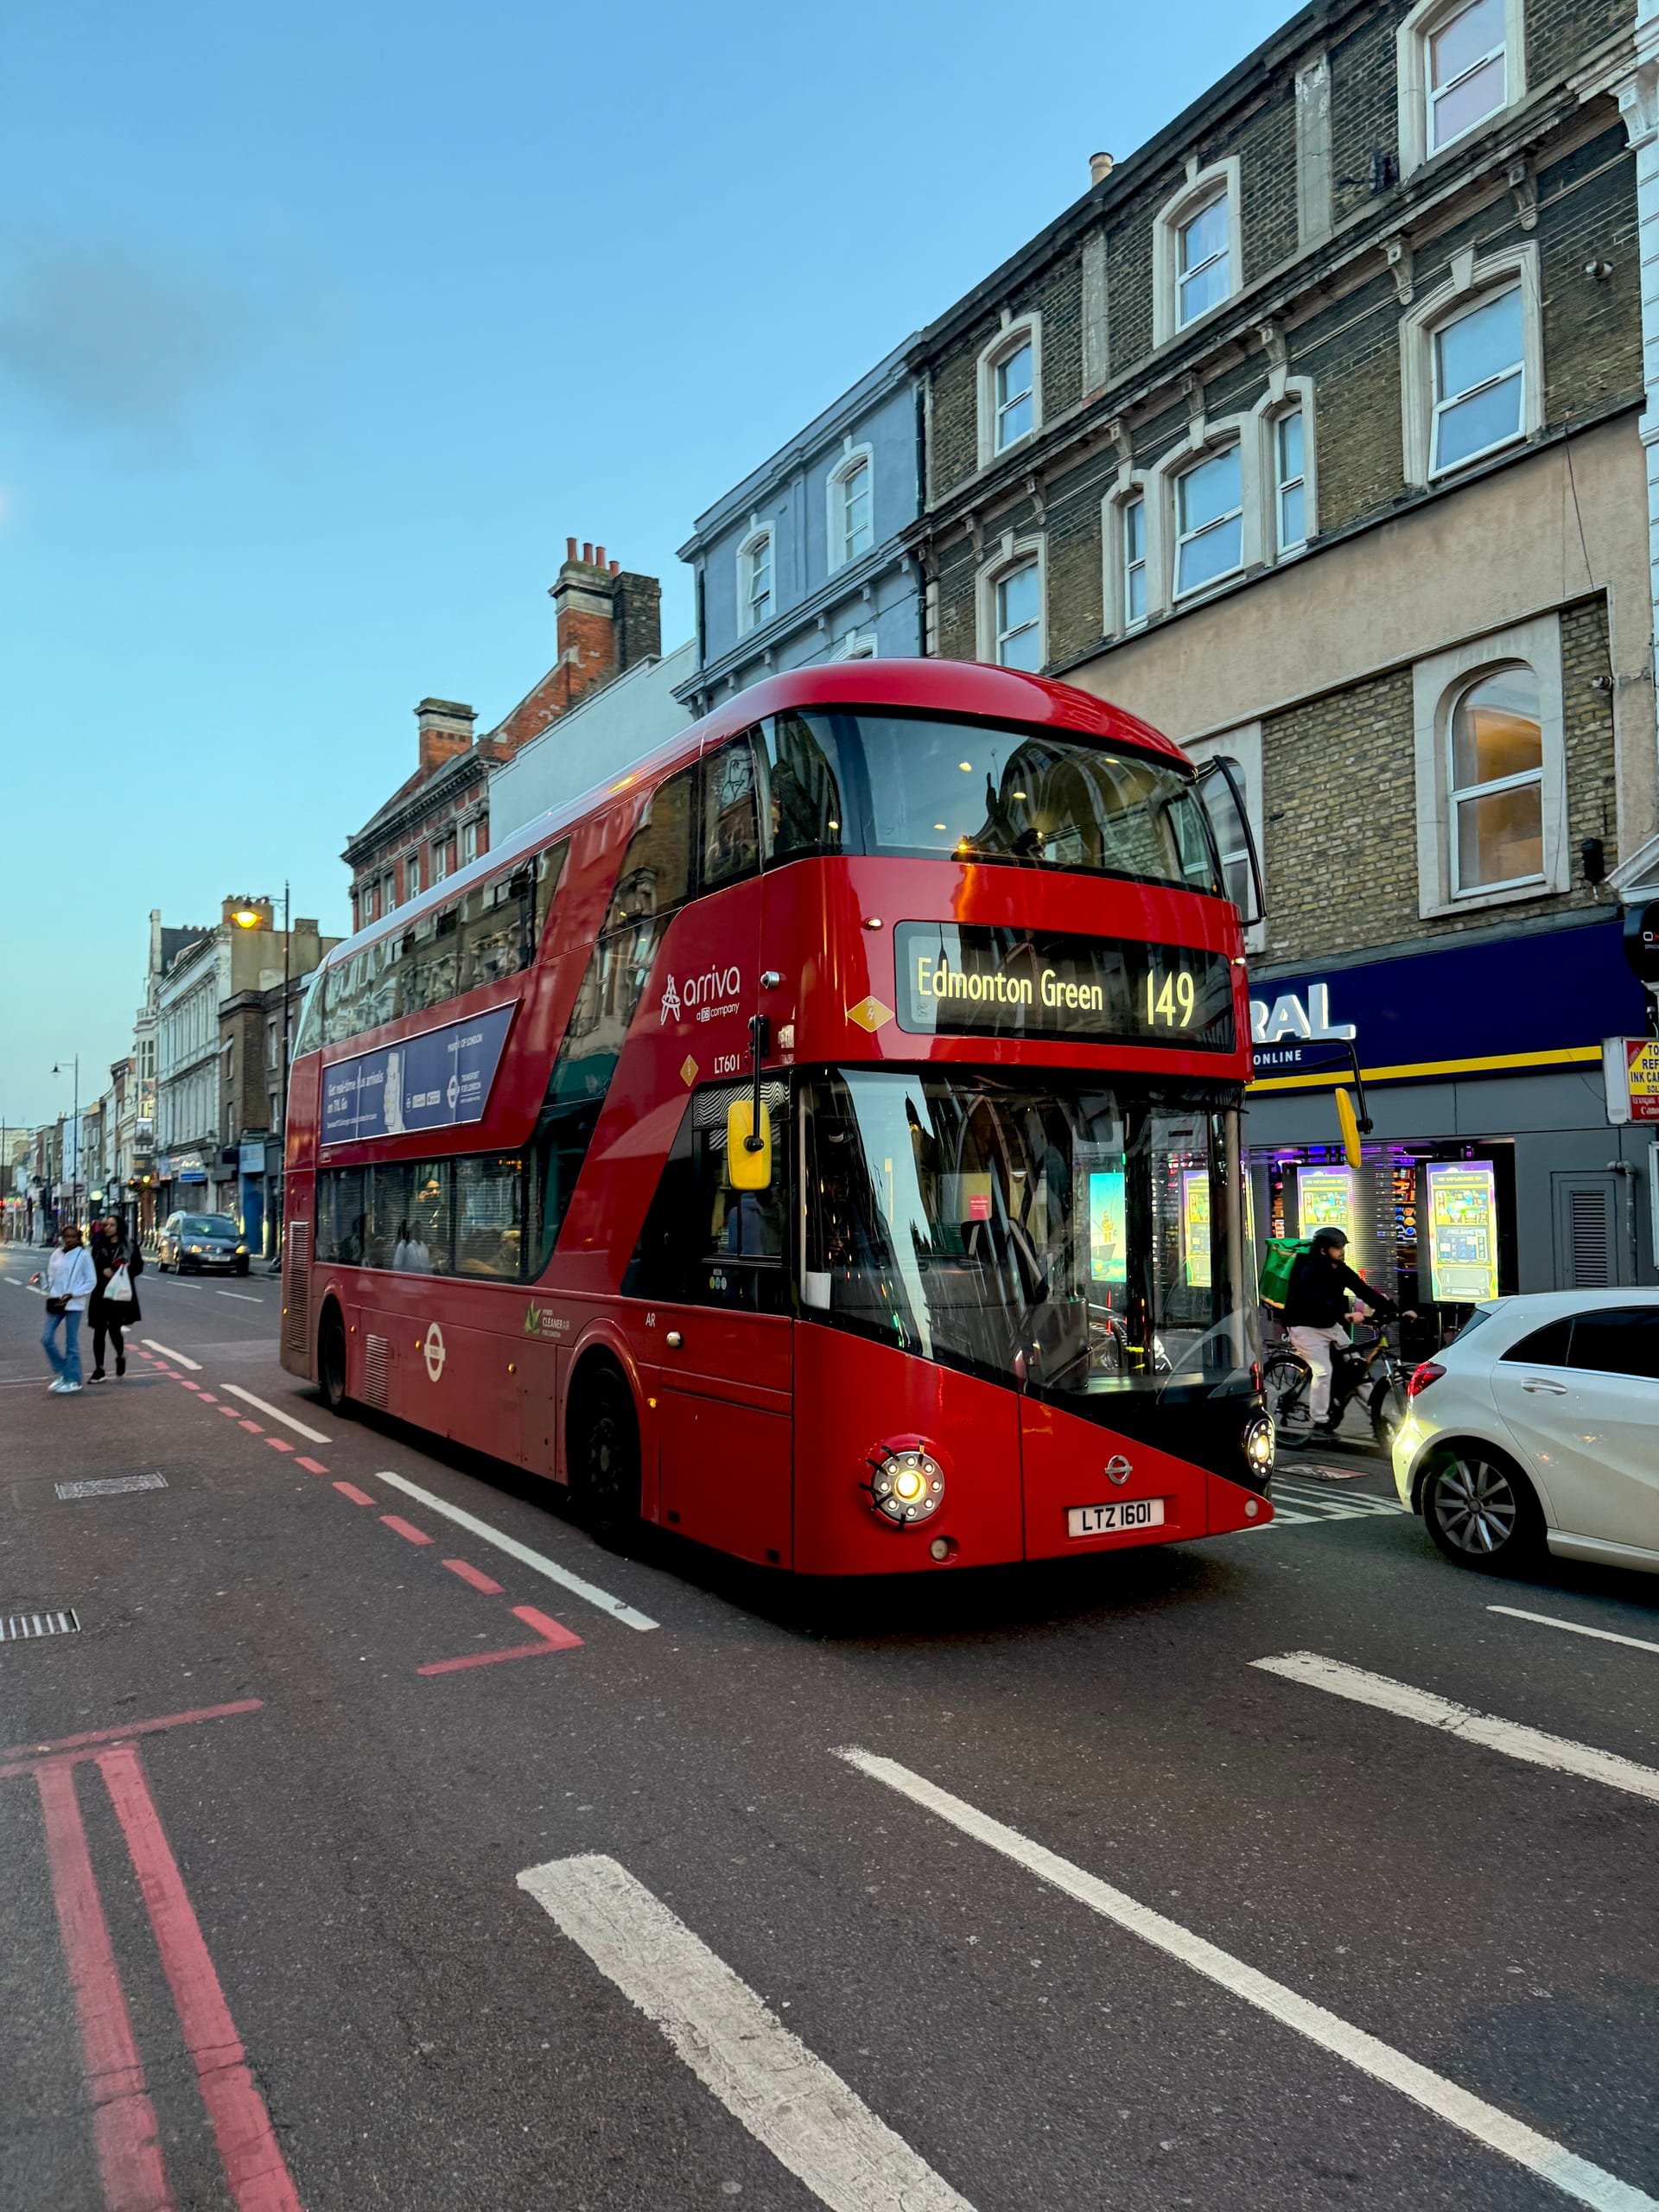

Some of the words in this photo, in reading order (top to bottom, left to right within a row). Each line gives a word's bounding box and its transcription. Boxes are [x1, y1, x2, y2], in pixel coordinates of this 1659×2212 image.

[683, 964, 741, 1007] arriva
[918, 957, 1032, 1004] Edmonton
[1041, 969, 1103, 1010] Green
[1147, 969, 1195, 1027] 149
[710, 1002, 740, 1017] company
[714, 1053, 741, 1074] LT601
[1253, 1049, 1302, 1065] ONLINE
[1630, 1071, 1645, 1083] INK
[645, 1313, 656, 1327] AR
[1082, 1507, 1116, 1531] LTZ
[1121, 1503, 1151, 1526] 1601
